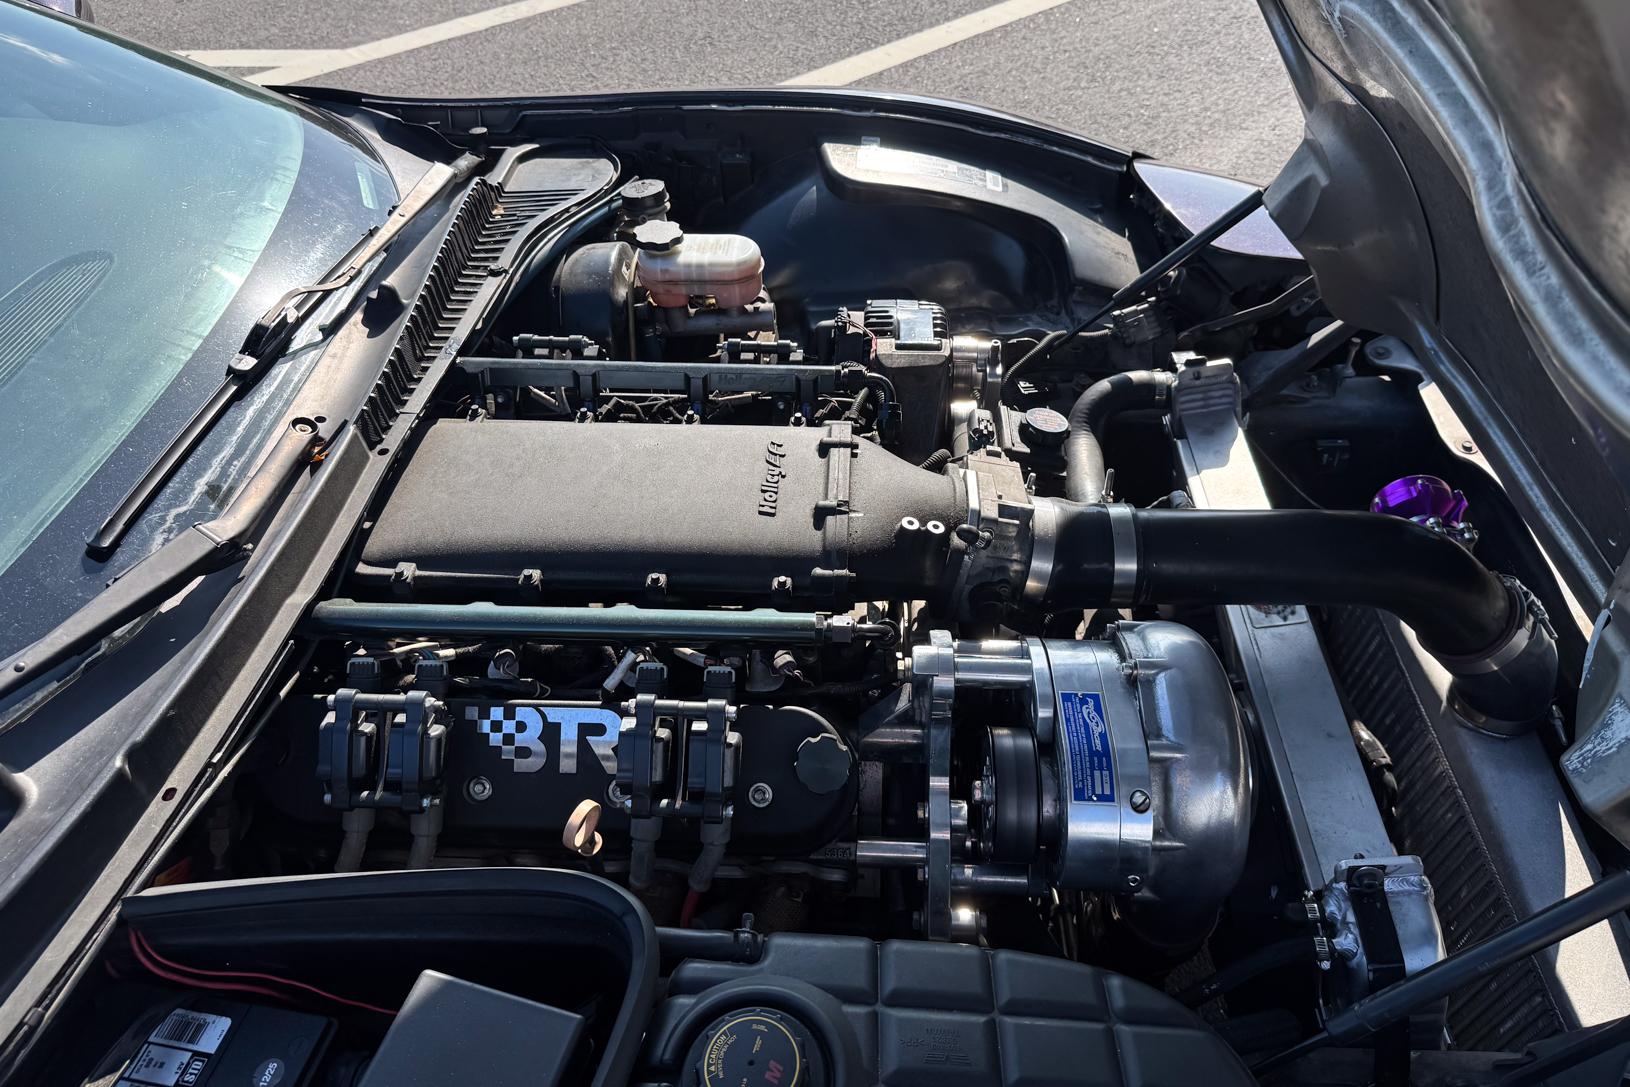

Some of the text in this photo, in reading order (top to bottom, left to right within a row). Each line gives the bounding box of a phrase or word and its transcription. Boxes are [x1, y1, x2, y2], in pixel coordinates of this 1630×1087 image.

[465, 706, 622, 774] BTR
[709, 1034, 727, 1064] CAUTION
[184, 1060, 204, 1082] STD
[259, 1062, 278, 1087] 12/25
[764, 1060, 784, 1085] M
